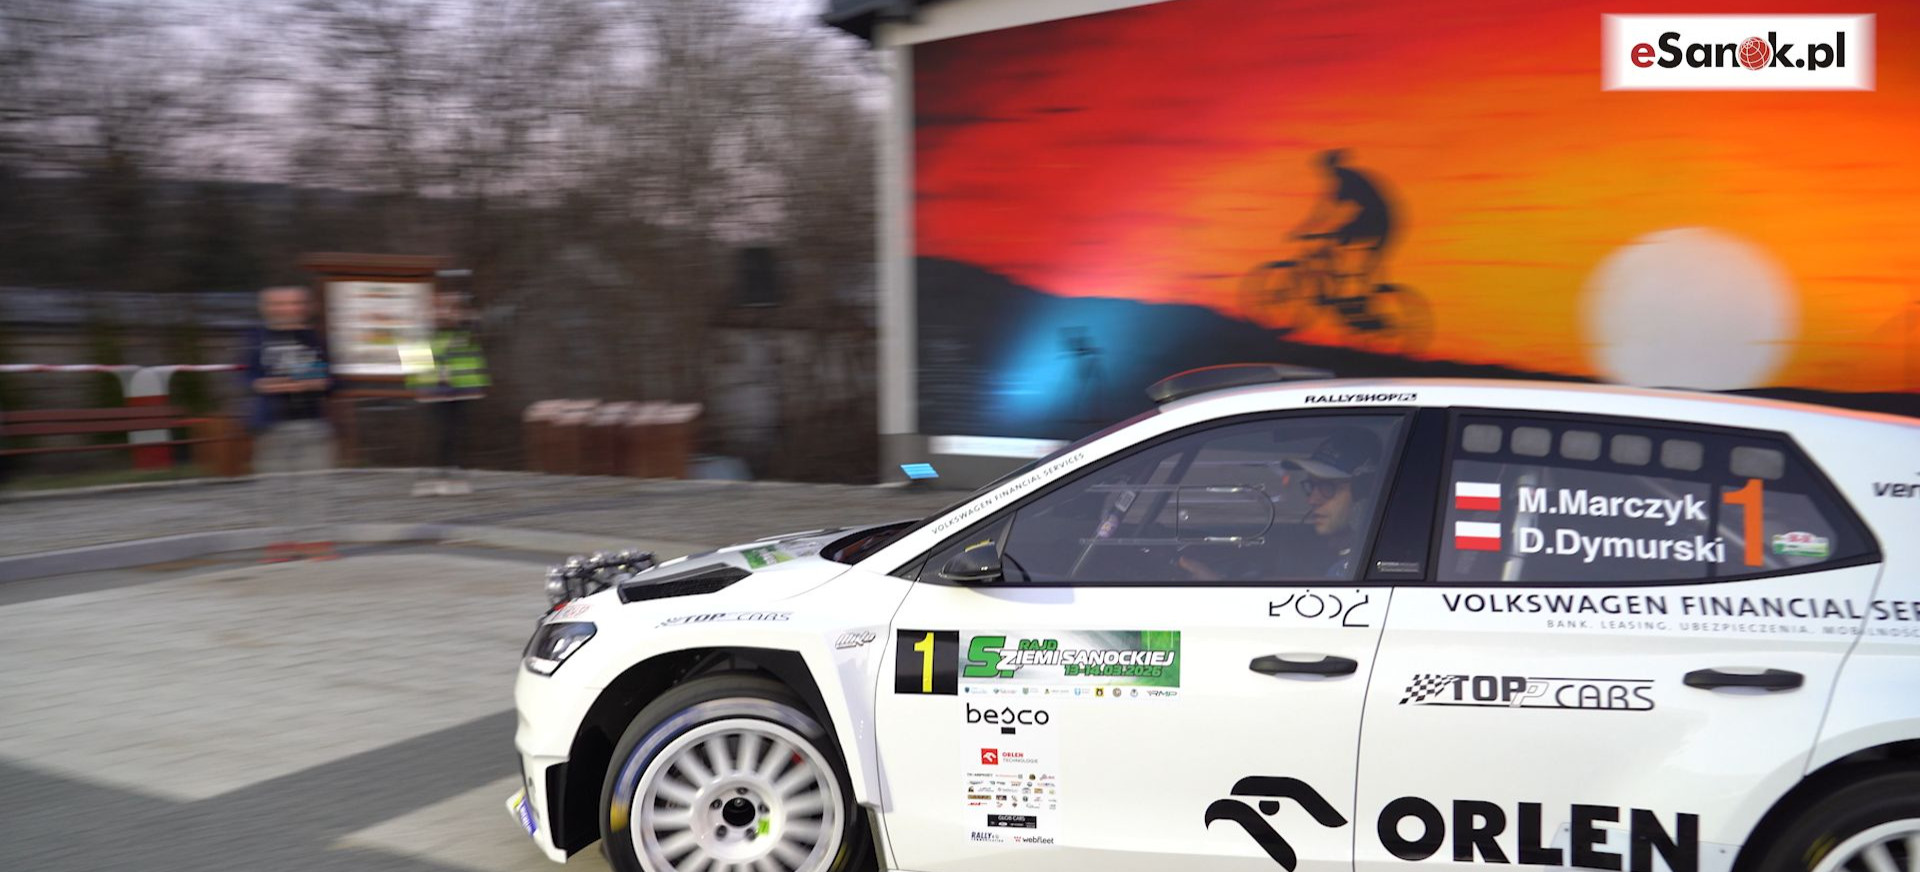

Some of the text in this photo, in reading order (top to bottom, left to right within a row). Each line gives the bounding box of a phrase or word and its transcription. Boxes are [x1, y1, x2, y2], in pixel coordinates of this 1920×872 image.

[932, 453, 1084, 534] VOLKSWAGEN FINANCIAL SERVICES
[1518, 486, 1707, 526] M.Marczyk
[1723, 478, 1763, 567] 1
[1519, 528, 1726, 564] D.Dymurski
[1442, 594, 1669, 615] VOLKSWAGEN
[1680, 596, 1865, 619] FINANCIAL
[914, 632, 934, 692] 1
[997, 650, 1175, 671] ZIEMI SANOCKIEJ
[1018, 639, 1058, 651] RAJD
[1555, 684, 1655, 710] CARS
[1377, 796, 1700, 872] ORLEN
